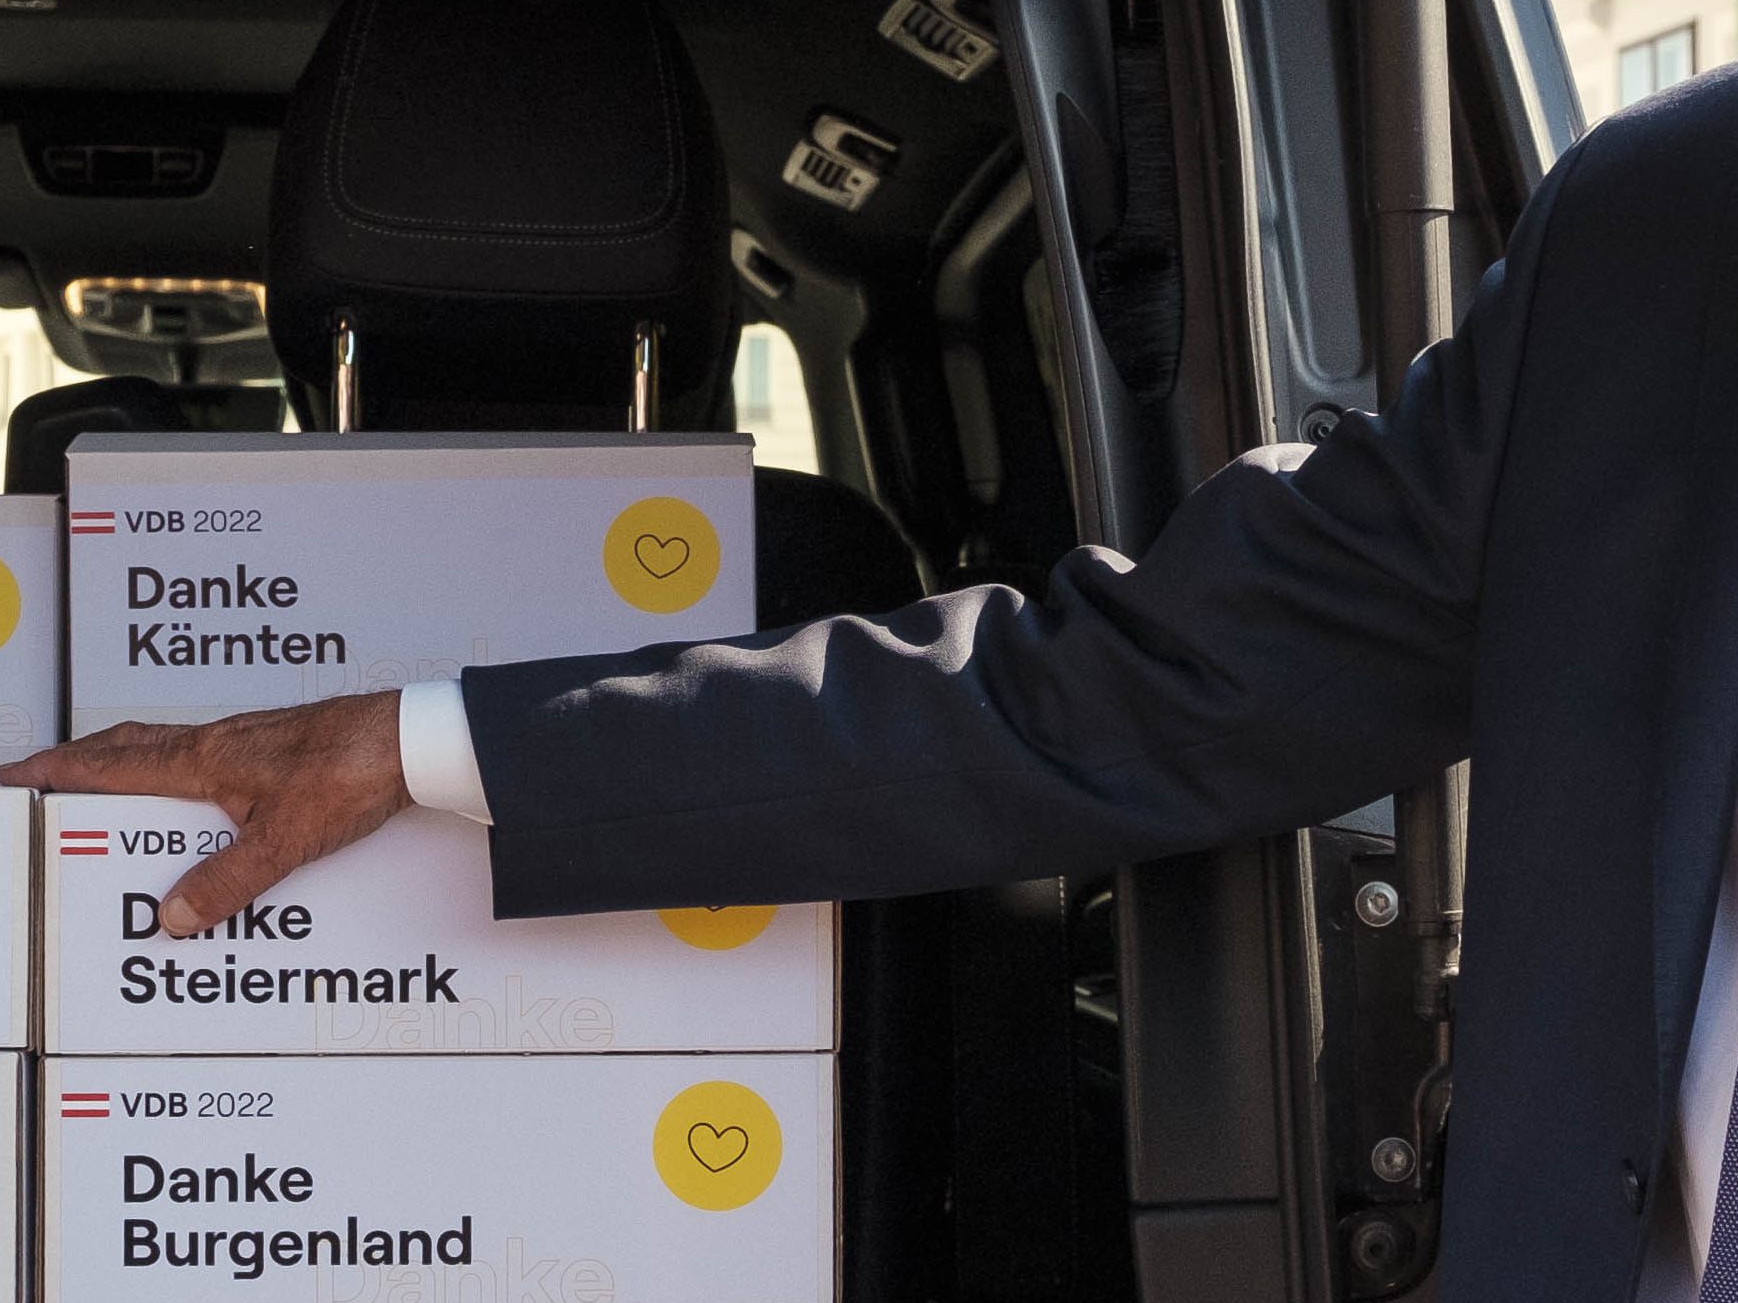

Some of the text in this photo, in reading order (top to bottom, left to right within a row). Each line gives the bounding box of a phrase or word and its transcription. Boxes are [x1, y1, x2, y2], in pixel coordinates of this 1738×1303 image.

[125, 510, 262, 533] VDB 2022
[128, 564, 298, 609] Danke
[129, 623, 345, 666] Kärnten
[120, 831, 186, 855] VDB
[121, 954, 460, 1003] Steiermark
[121, 1093, 273, 1117] VDB 2022
[124, 1153, 313, 1203] Danke
[124, 1216, 471, 1279] Burgenland
